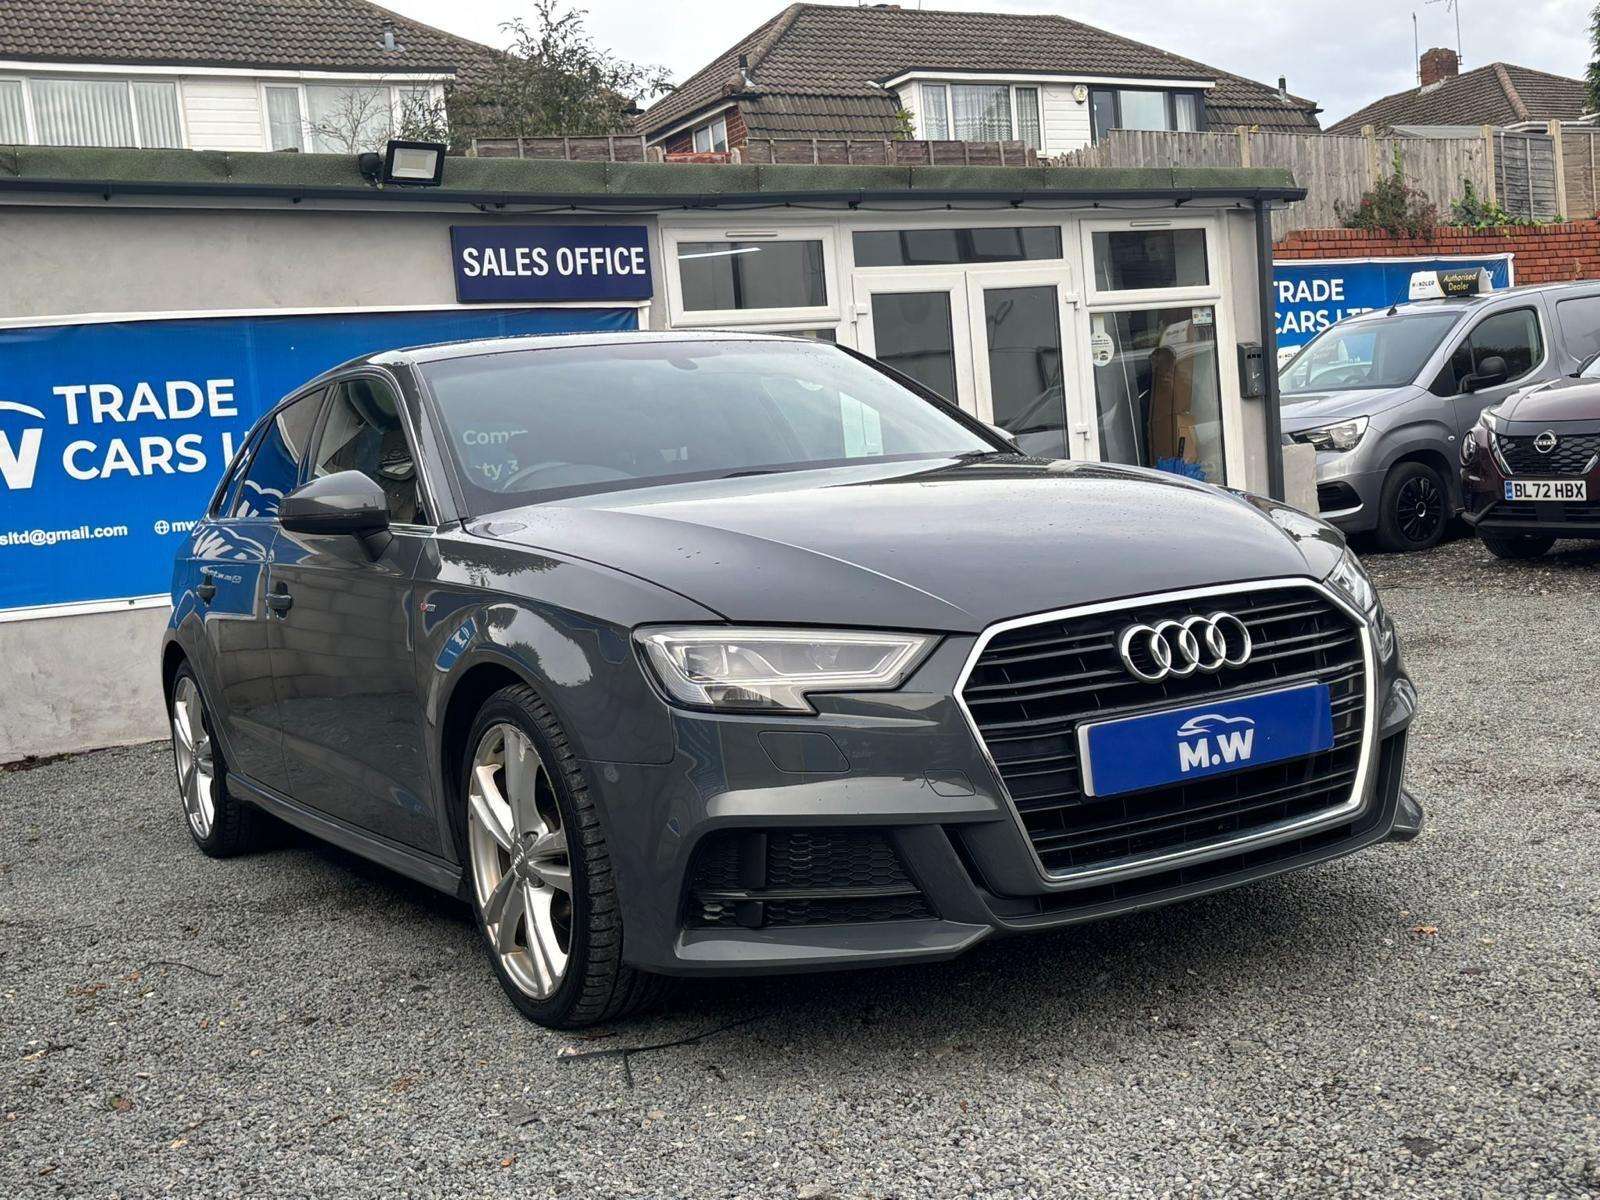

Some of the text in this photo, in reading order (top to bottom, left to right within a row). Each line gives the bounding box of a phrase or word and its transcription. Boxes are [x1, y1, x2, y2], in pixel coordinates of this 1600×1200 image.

[462, 247, 647, 277] SALES OFFICE
[1443, 272, 1478, 282] Authorised
[1448, 283, 1469, 291] Dealer
[53, 379, 238, 425] TRADE
[62, 433, 207, 480] CARS
[1513, 483, 1551, 498] BL72
[1555, 483, 1584, 498] HBX
[0, 525, 128, 546] sltd@gmail.com
[1178, 728, 1254, 772] M.W
